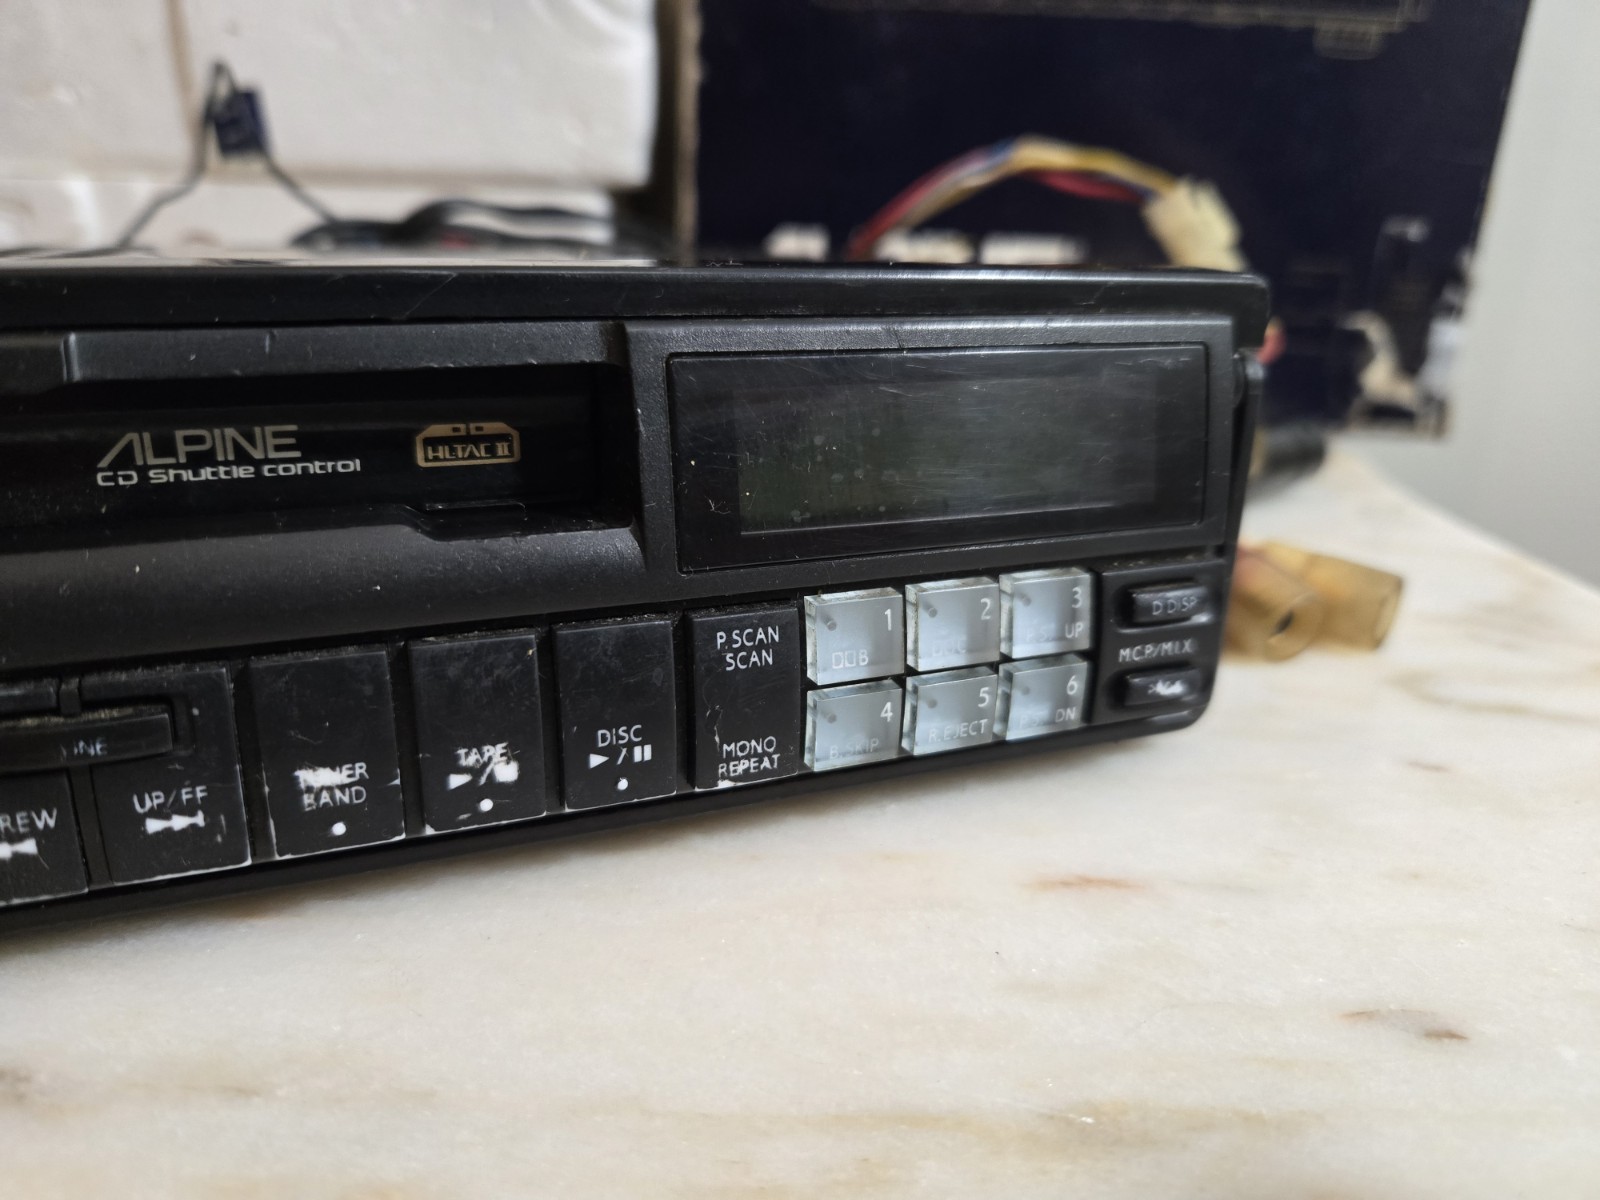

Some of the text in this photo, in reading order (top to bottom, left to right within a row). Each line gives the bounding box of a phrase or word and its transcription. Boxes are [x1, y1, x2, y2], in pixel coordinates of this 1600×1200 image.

[97, 424, 302, 468] ALPINE
[97, 458, 361, 486] CD Shuttle control
[1071, 586, 1082, 609] 3
[884, 608, 892, 631] 1
[980, 598, 991, 621] 2
[1065, 621, 1084, 639] UP
[725, 648, 774, 671] SCAN
[977, 686, 990, 708] 5
[1066, 675, 1078, 696] 6
[880, 701, 894, 723] 4
[1055, 706, 1077, 723] DN
[597, 725, 642, 747] DISC
[722, 736, 777, 759] MONO
[455, 742, 509, 768] TAPE
[718, 753, 781, 777] REPEAT
[133, 785, 208, 814] UP/FF
